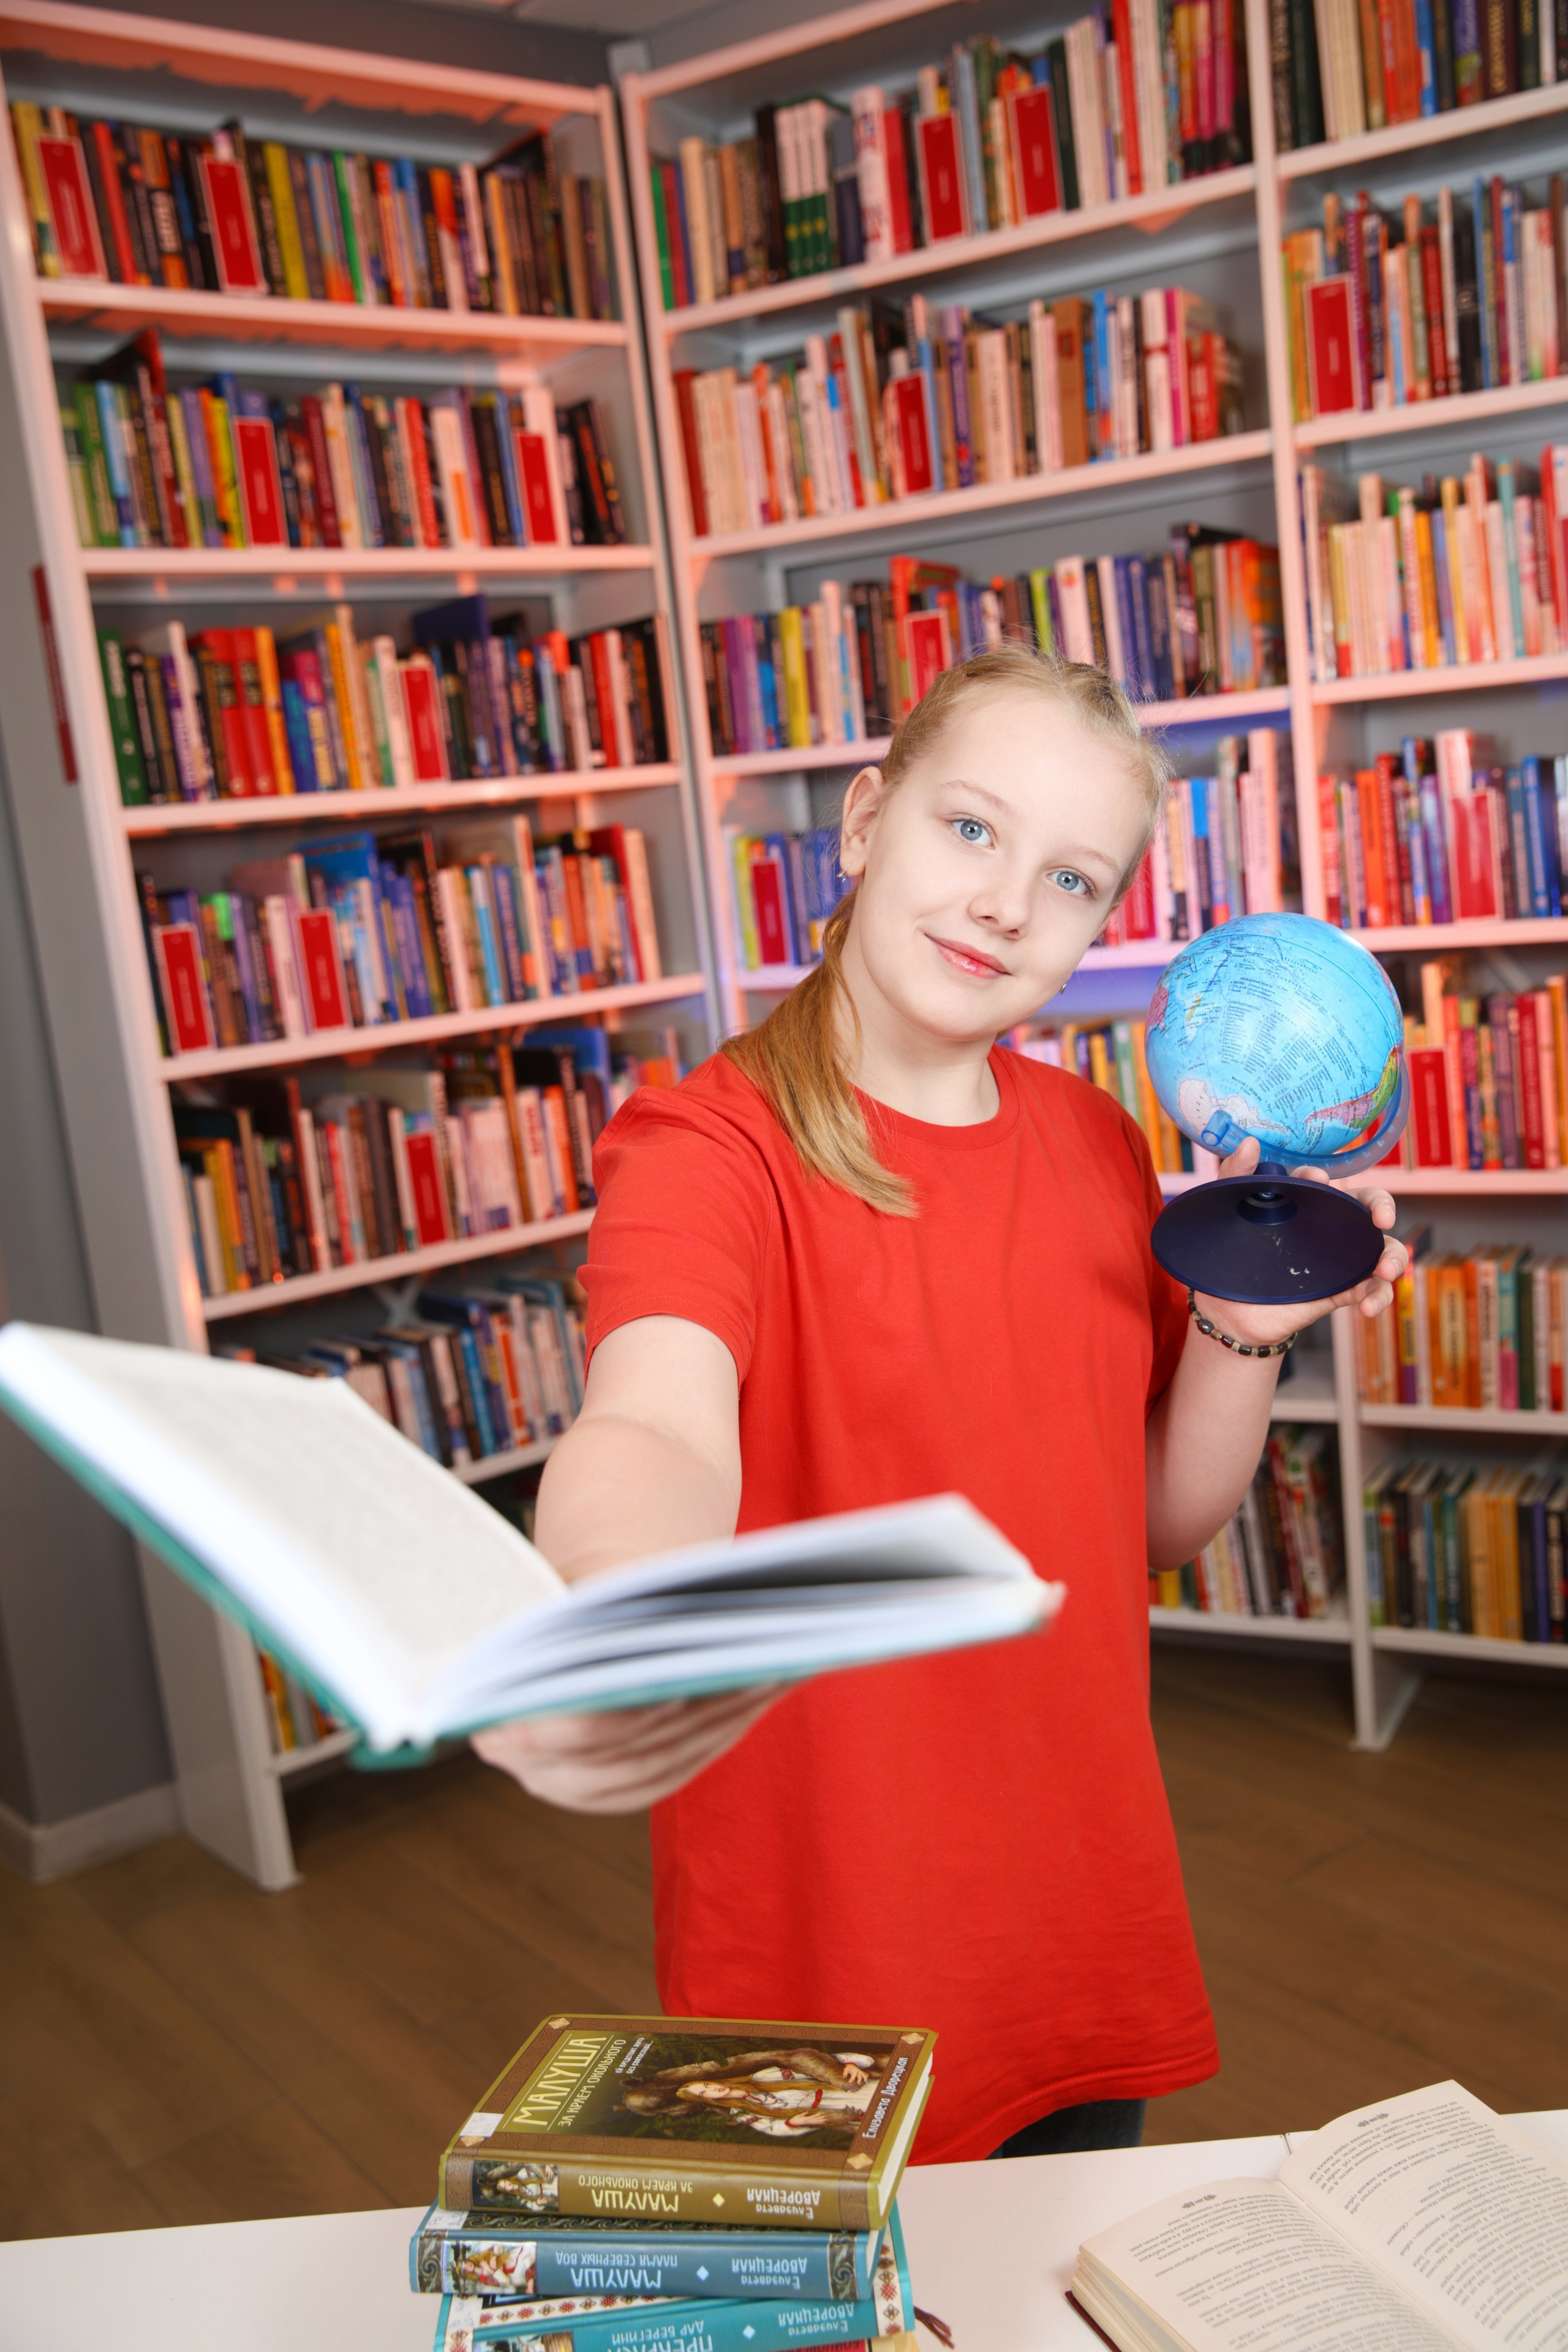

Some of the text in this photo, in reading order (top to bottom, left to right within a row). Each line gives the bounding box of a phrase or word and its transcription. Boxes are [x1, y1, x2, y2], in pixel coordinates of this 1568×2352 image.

[619, 2047, 638, 2068] ПРЕДСТОИТ
[633, 2037, 645, 2047] ЖИТЬ
[513, 2037, 607, 2125] МАЛУША
[558, 2039, 627, 2126] ЗА КРАЕМ ОКОЛЬНОГО
[1316, 2155, 1333, 2169] билось
[1326, 2168, 1341, 2182] чтобы
[1339, 2166, 1353, 2179] место.
[1388, 2169, 1400, 2178] лицо
[578, 2174, 693, 2193] ЗА КРАЕМ ОКОЛЬНОГО
[1357, 2177, 1376, 2193] нижней
[1360, 2182, 1381, 2201] постучал
[591, 2188, 679, 2212] МАЛУША
[747, 2187, 821, 2206] ДВОРЕЦКАЯ
[1344, 2194, 1357, 2209] губой
[755, 2204, 813, 2219] Елизавета
[1350, 2202, 1360, 2214] себя
[556, 2250, 677, 2267] ПЛАМЯ СЕВЕРНЫХ ВОД
[732, 2257, 807, 2274] ДВОРЕЦКАЯ
[570, 2268, 662, 2288] МАЛУША
[741, 2274, 800, 2289] Елизавета
[778, 2302, 854, 2327] ДВОРЕЦКАЯ
[611, 2319, 704, 2345] ДАР БЕРЕГИНИ
